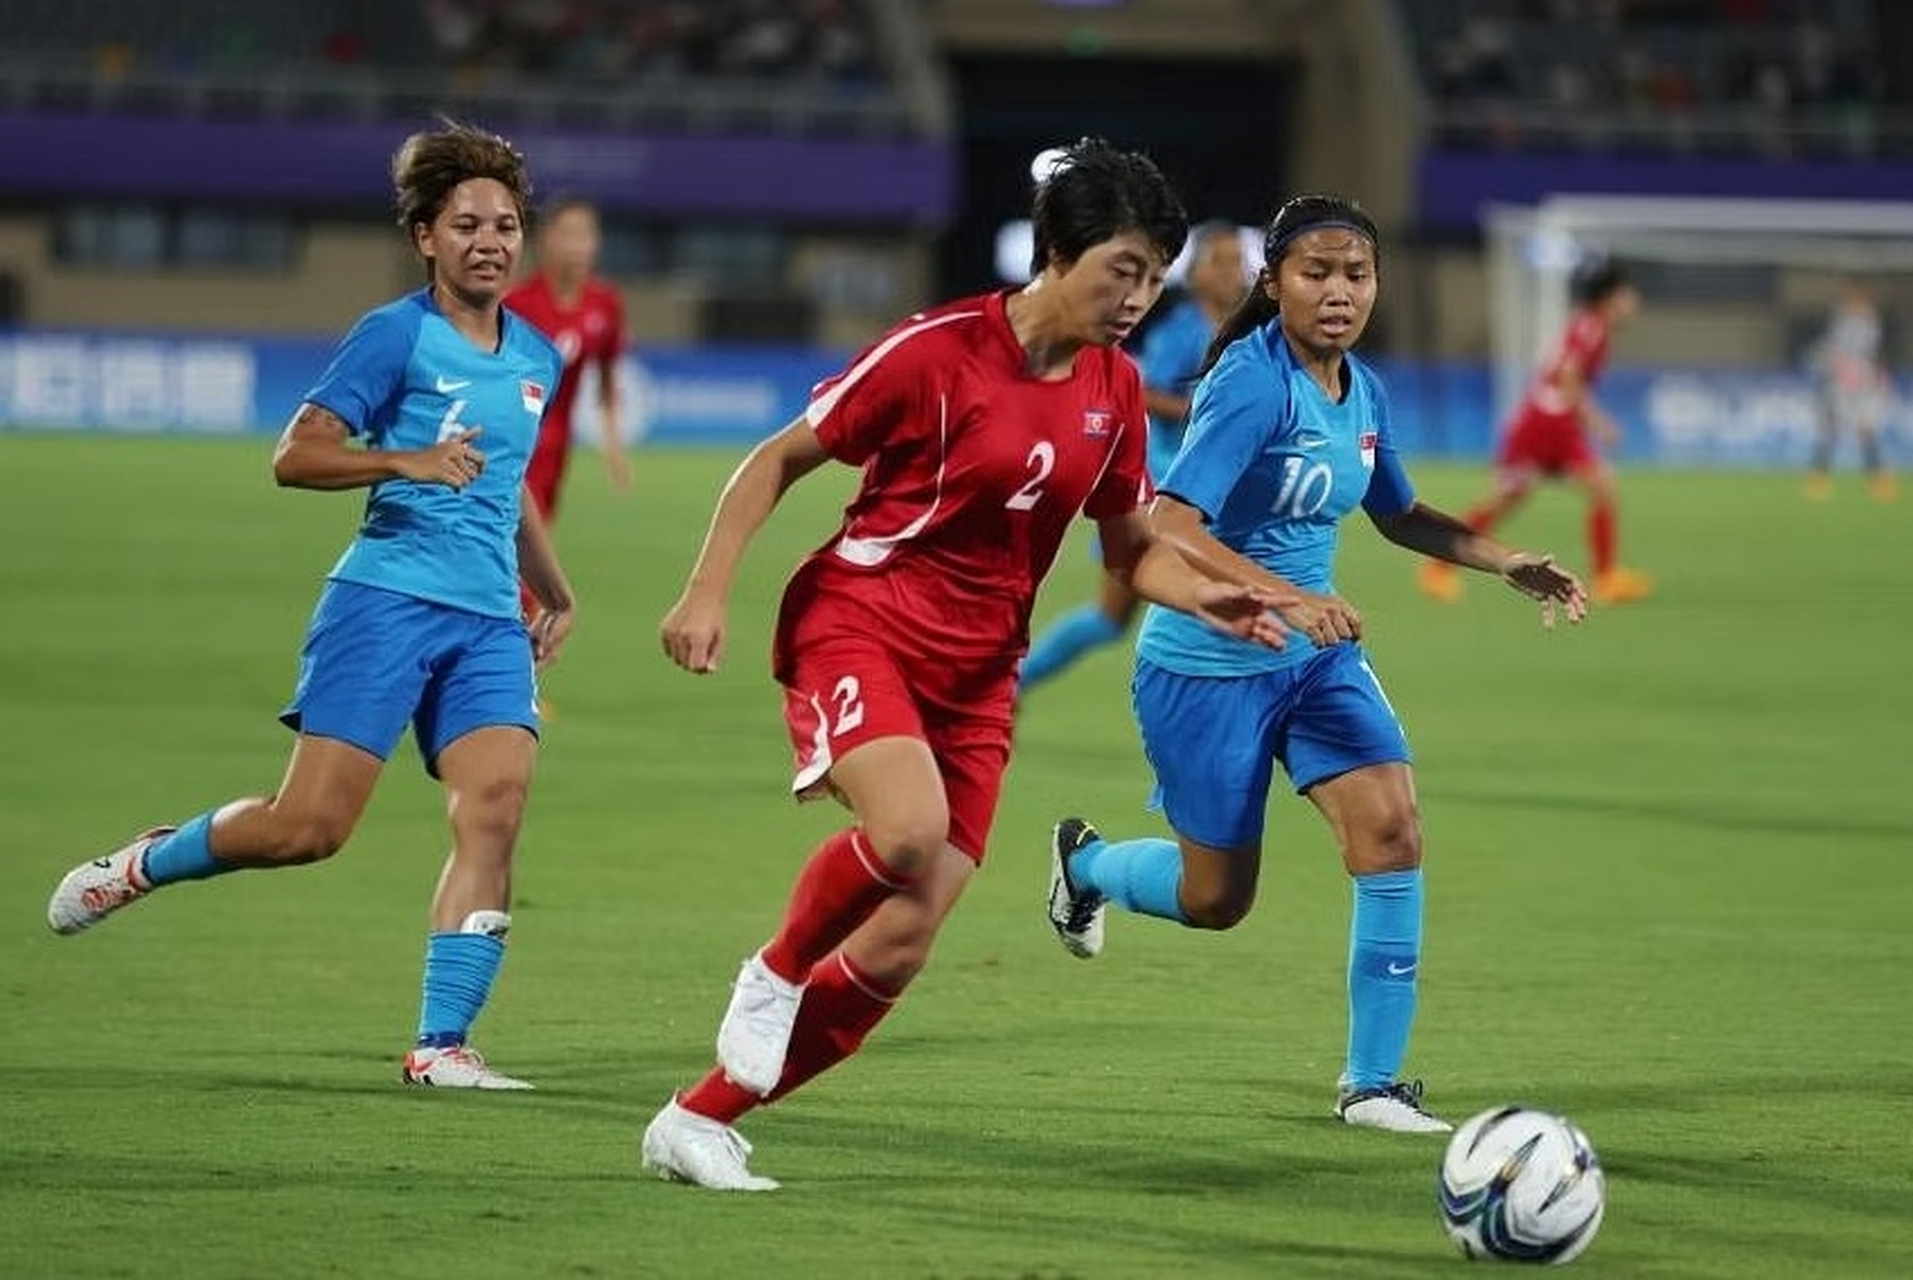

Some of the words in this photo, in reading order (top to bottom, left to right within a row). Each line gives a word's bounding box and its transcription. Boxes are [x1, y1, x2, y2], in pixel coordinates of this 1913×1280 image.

[436, 399, 467, 443] 6
[1004, 440, 1055, 511] 2
[1270, 456, 1332, 519] 10
[830, 675, 864, 738] 2
